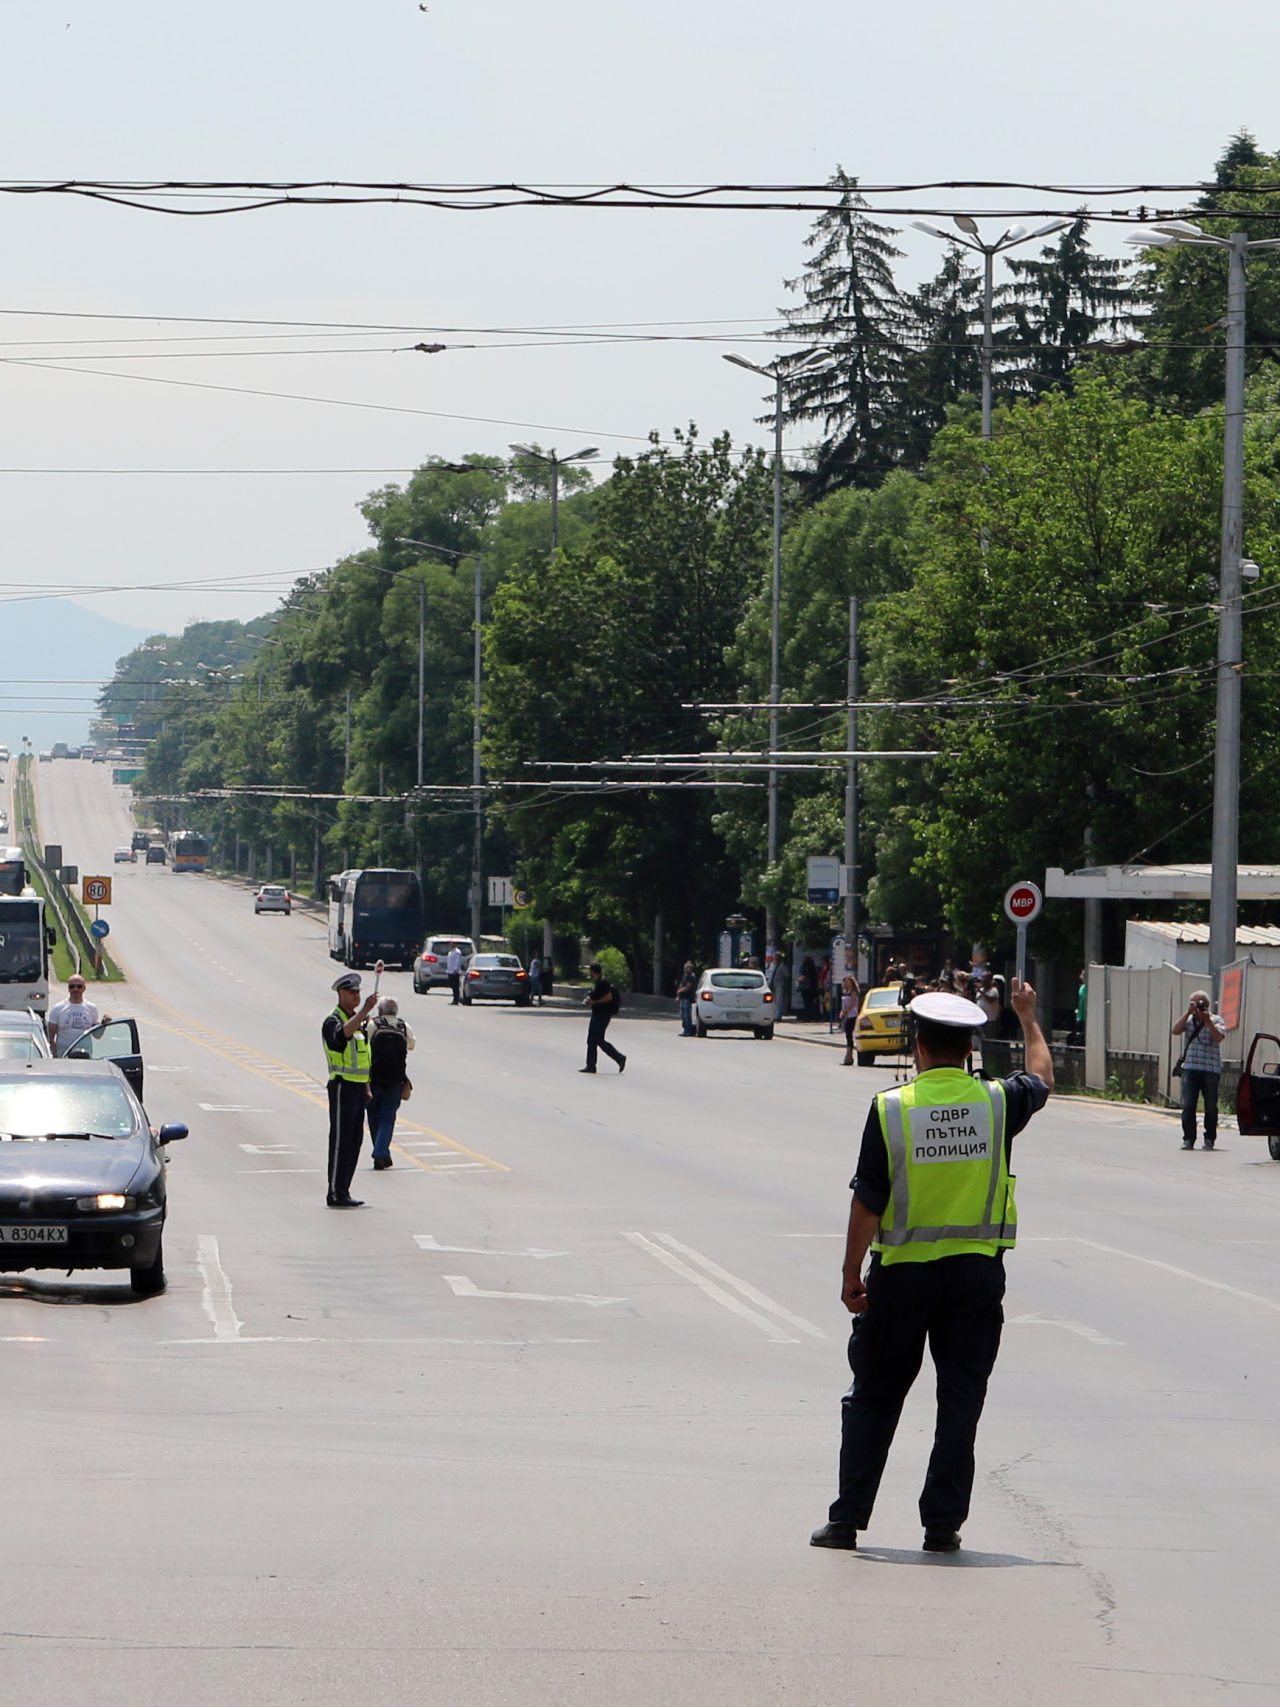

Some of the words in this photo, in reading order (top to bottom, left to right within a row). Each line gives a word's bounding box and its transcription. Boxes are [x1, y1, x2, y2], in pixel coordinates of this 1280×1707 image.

[89, 884, 104, 896] 80
[1012, 897, 1033, 908] МВР
[930, 1108, 970, 1123] СДВР
[926, 1126, 978, 1140] ПЪТНА
[915, 1142, 987, 1158] ПОЛИЦИЯ
[12, 1228, 45, 1241] 8304
[47, 1228, 65, 1241] KX
